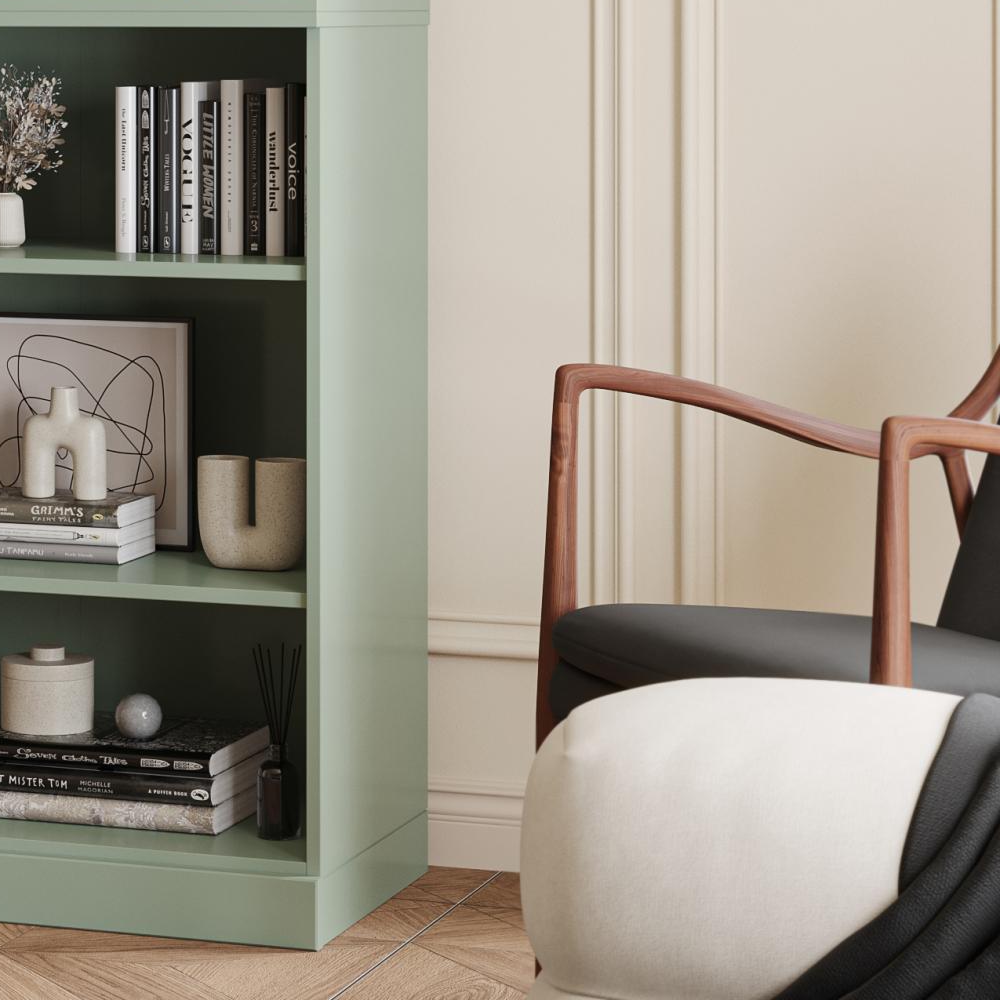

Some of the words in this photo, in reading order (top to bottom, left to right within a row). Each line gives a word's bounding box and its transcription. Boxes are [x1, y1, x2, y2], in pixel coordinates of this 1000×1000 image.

[202, 112, 214, 161] LITTLE
[182, 118, 192, 223] VOGUE
[268, 132, 280, 212] wanderlust
[202, 164, 214, 220] WOMEN
[30, 506, 84, 518] GRIMM'S
[8, 775, 45, 788] MISTER
[48, 778, 68, 790] TOM
[78, 786, 114, 794] MAGORIAN
[80, 780, 111, 788] MICHELLE
